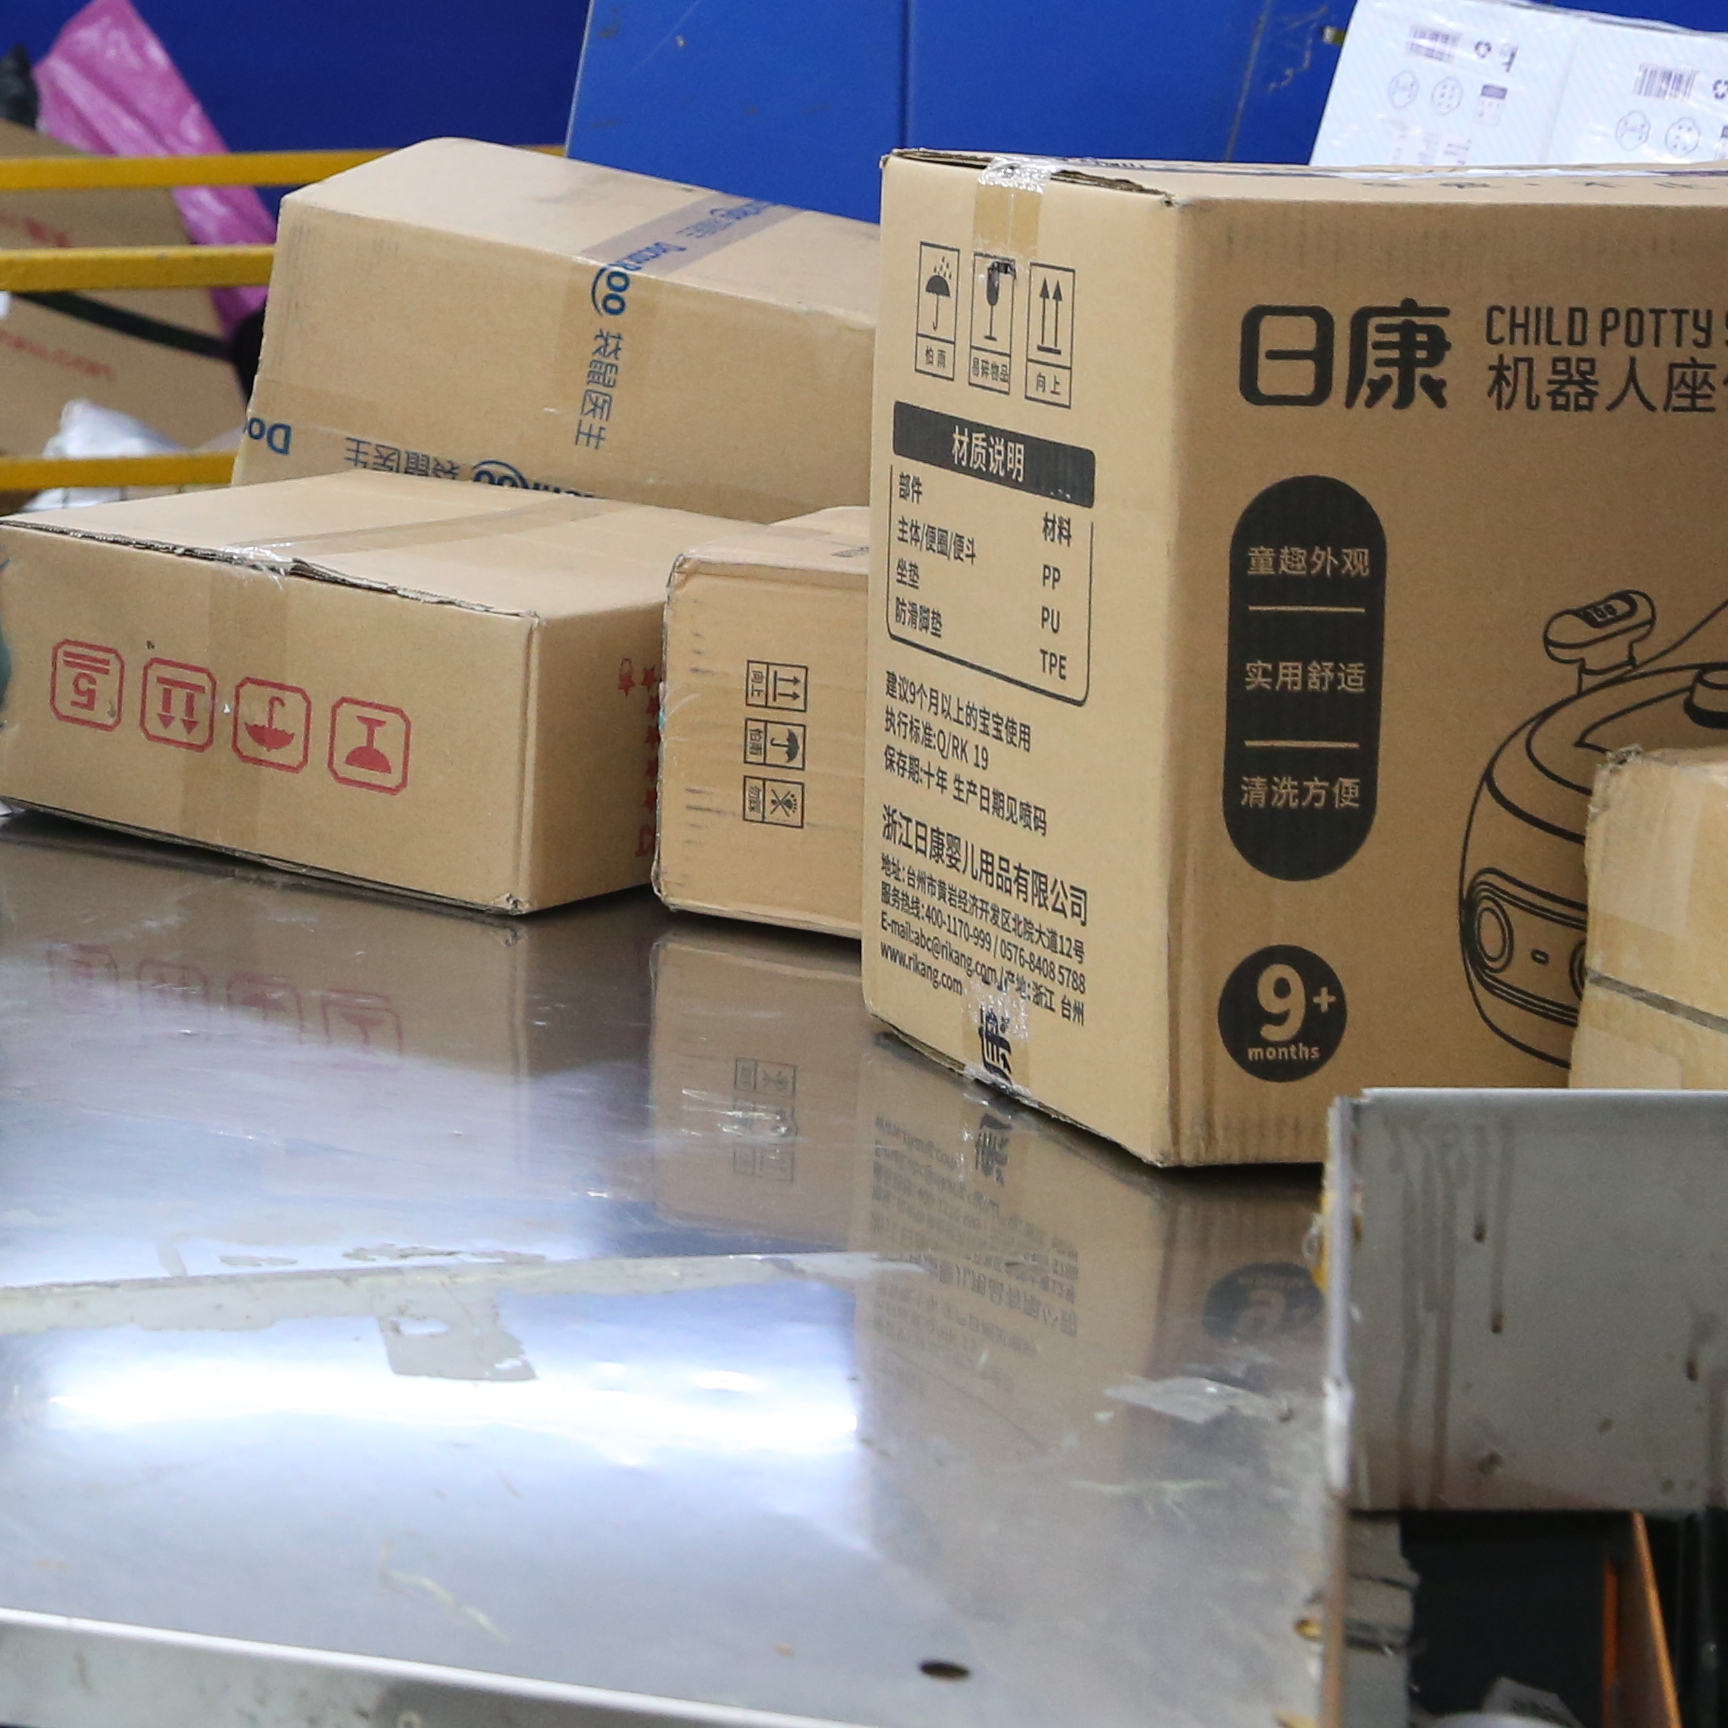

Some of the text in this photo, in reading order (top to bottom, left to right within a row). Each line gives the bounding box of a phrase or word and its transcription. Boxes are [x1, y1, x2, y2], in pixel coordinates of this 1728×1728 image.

[1486, 304, 1589, 347] CHILD
[1600, 306, 1714, 349] POTTY
[1239, 297, 1452, 410] 日康
[574, 327, 624, 451] 袋鼠医生
[1035, 372, 1062, 397] 向上
[1486, 354, 1728, 414] 机器人座
[951, 424, 1026, 484] 材质说明
[898, 471, 923, 505] 部件
[1041, 511, 1073, 548] 材料
[895, 557, 921, 591] 坐垫
[1042, 563, 1062, 591] PP
[1247, 545, 1370, 579] 童趣外观
[1040, 605, 1061, 635] PU
[1039, 647, 1067, 681] TPE
[1243, 659, 1367, 694] 实用舒适
[750, 669, 766, 698] 向上
[885, 669, 1032, 754] 建议9个月以上的宝宝使用
[1240, 775, 1361, 810] 清洗方便
[881, 803, 1089, 927] 浙江日康婴儿用品有限公司
[880, 941, 964, 997] www.rikang.com
[1247, 1042, 1321, 1062] months
